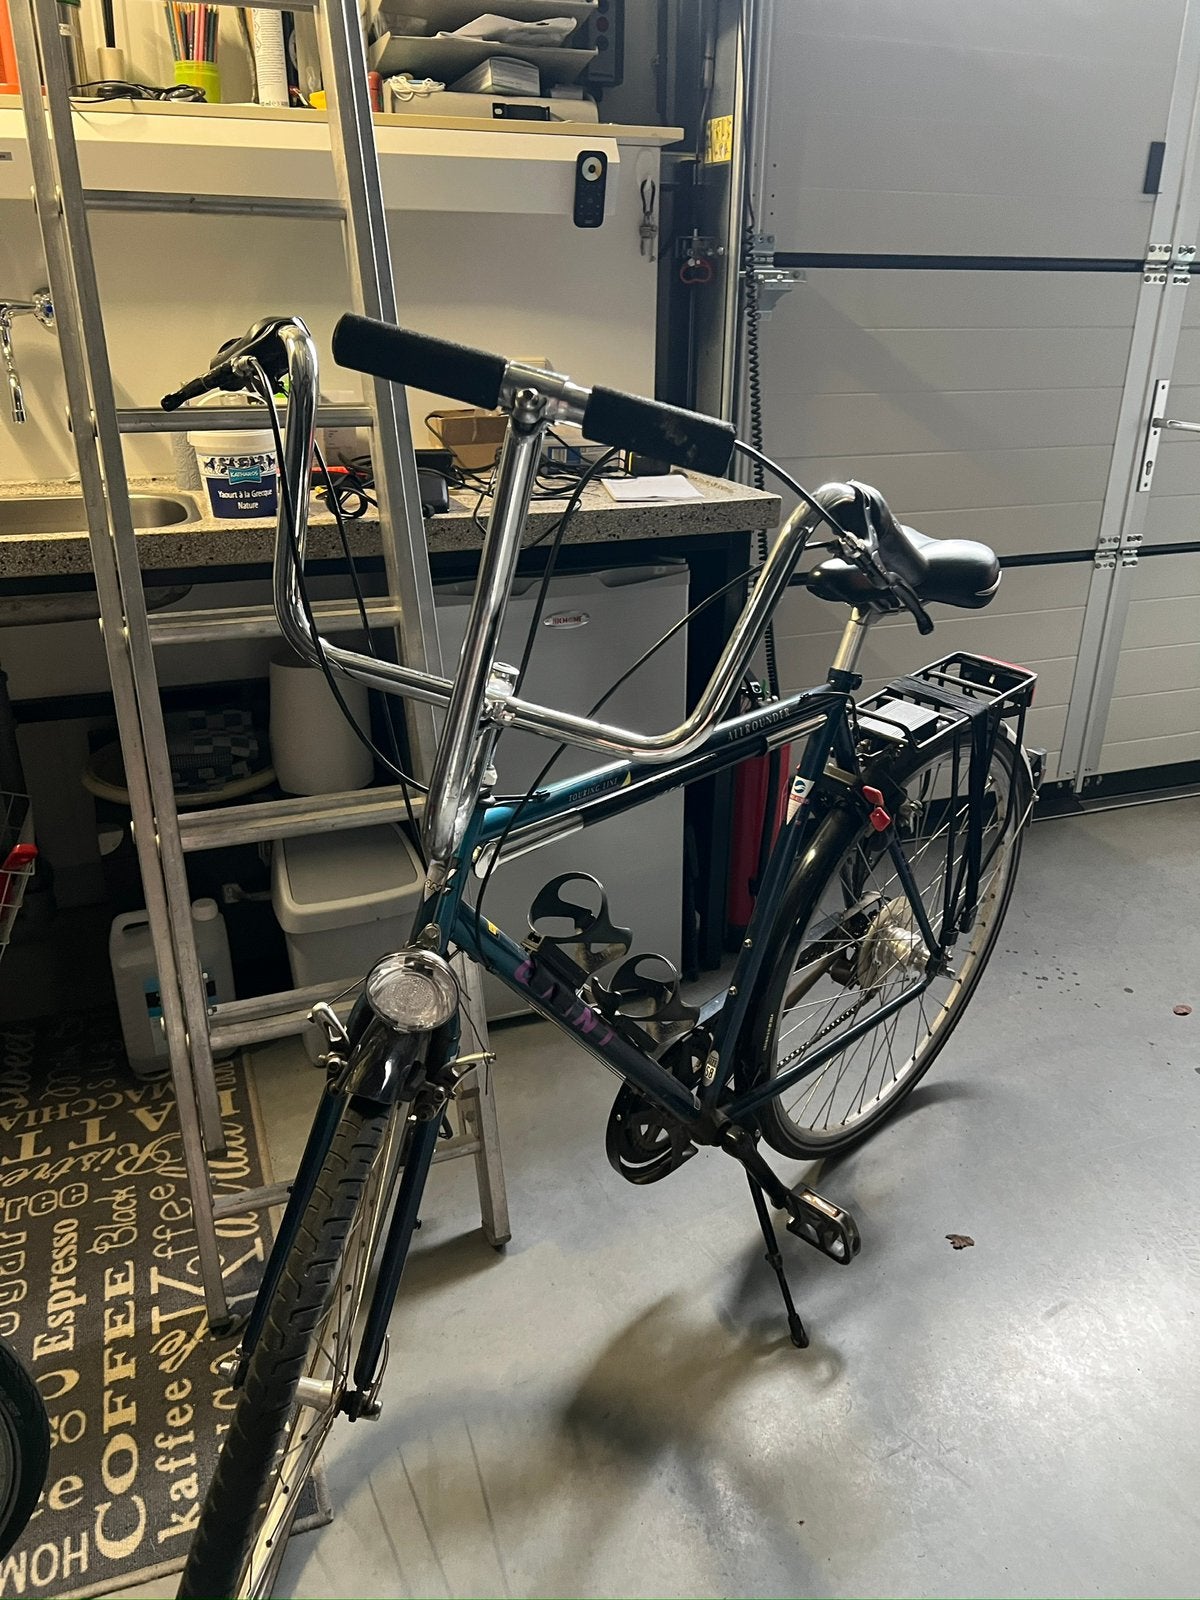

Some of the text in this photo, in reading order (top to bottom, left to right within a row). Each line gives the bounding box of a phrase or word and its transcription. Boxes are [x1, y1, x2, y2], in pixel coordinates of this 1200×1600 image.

[217, 489, 272, 499] Yaourt à la Grecque
[237, 502, 259, 510] Nature
[728, 707, 790, 741] ALLROUNDER
[568, 784, 600, 802] TOURING
[86, 1185, 138, 1255] Black
[33, 1218, 87, 1361] Espresso
[94, 1260, 146, 1559] COFFEE
[155, 1376, 201, 1544] kaffee
